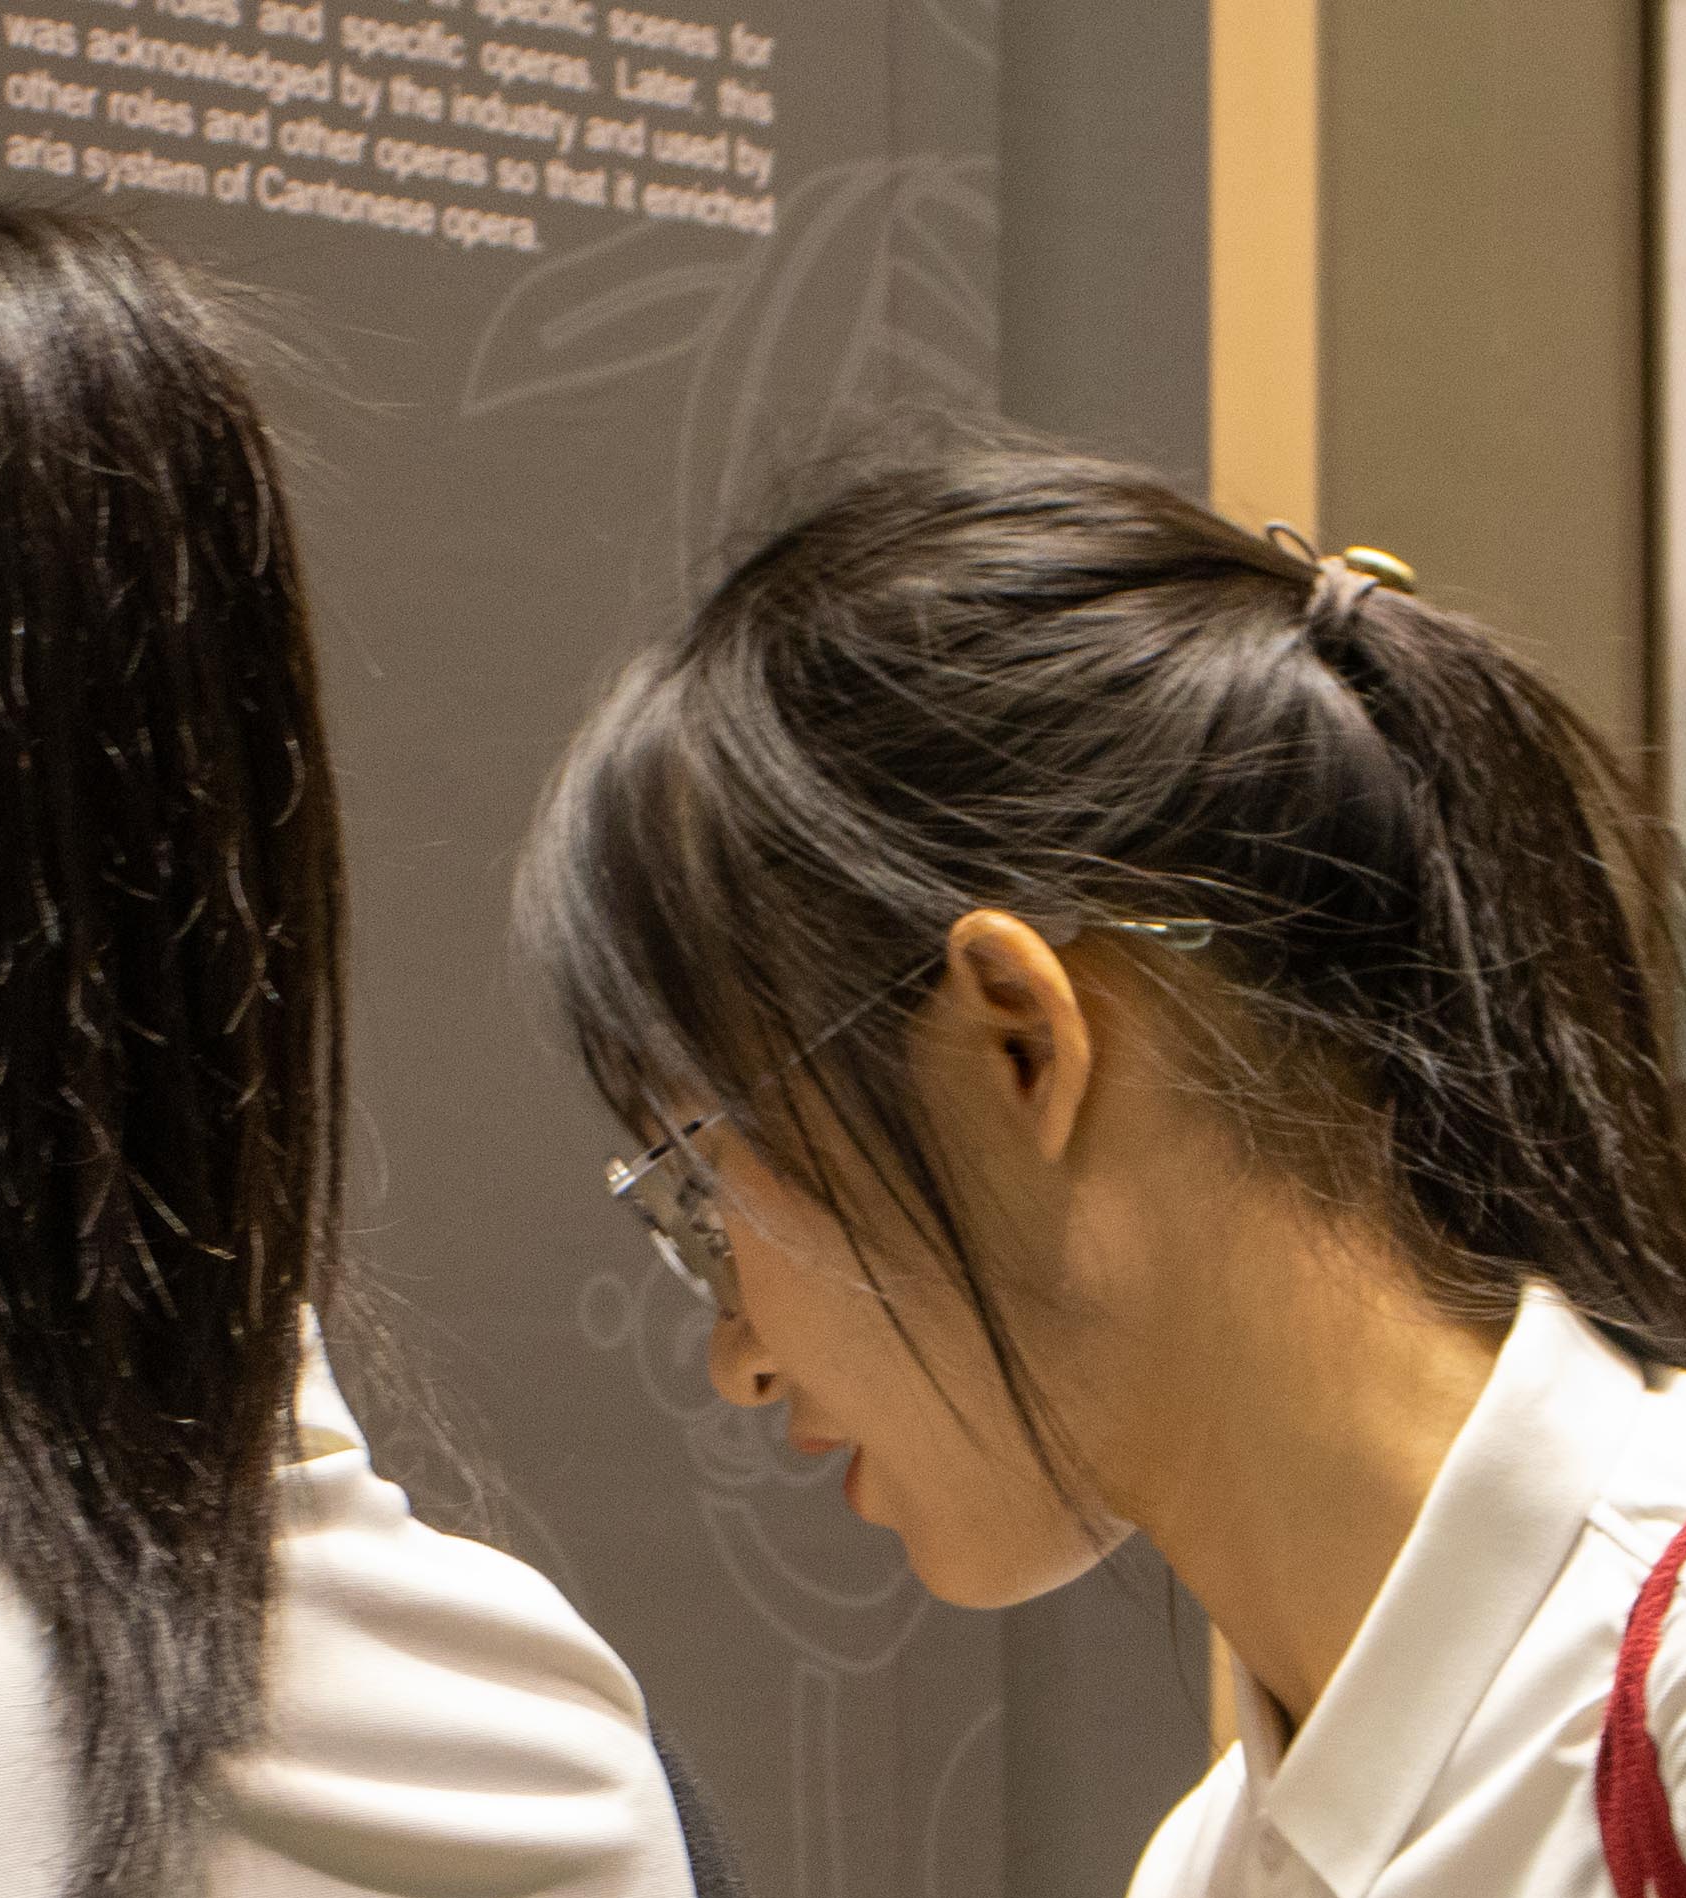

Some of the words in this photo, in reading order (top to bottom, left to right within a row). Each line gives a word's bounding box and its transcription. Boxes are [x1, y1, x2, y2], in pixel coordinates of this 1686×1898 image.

[3, 14, 79, 58] was
[86, 26, 333, 105] acknowledged
[339, 65, 383, 120] by
[388, 75, 444, 122] the
[450, 86, 578, 154] industry
[584, 115, 647, 158] and
[652, 130, 730, 173] used
[734, 136, 774, 189] by
[257, 0, 325, 42] and
[340, 15, 465, 69] specific
[717, 78, 775, 126] this
[729, 22, 775, 67] for
[4, 70, 99, 119] other
[107, 87, 196, 138] roles
[203, 107, 271, 151] and
[278, 117, 368, 165] other
[374, 137, 490, 188] operas
[496, 157, 539, 196] so
[544, 159, 608, 207] that
[614, 172, 637, 212] it
[641, 181, 776, 237] enriched
[5, 131, 76, 177] aria
[82, 146, 208, 196] system
[213, 160, 252, 204] of
[255, 165, 437, 236] Cantonese
